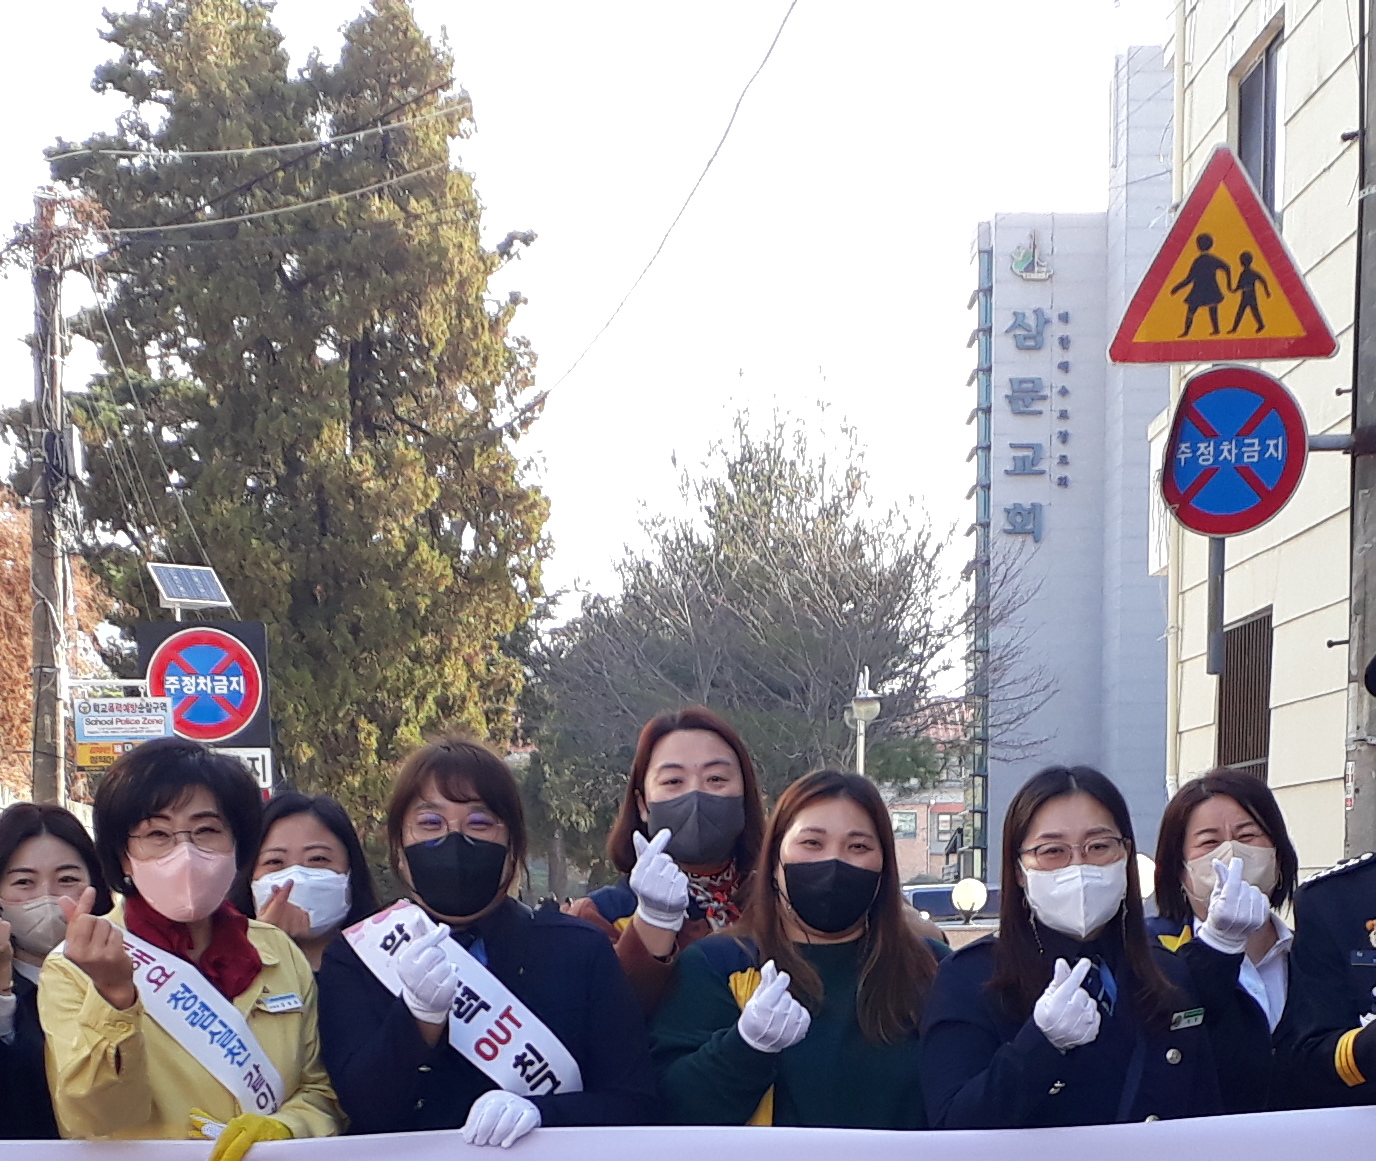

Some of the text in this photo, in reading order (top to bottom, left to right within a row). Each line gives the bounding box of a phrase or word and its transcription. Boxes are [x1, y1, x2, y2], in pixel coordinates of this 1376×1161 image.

[1003, 307, 1053, 543] 삼문교회
[1176, 435, 1284, 467] 주정차금지
[164, 675, 245, 695] 주정차금지
[85, 717, 114, 726] School
[165, 982, 252, 1069] 청렴실천
[473, 1004, 523, 1062] OUT
